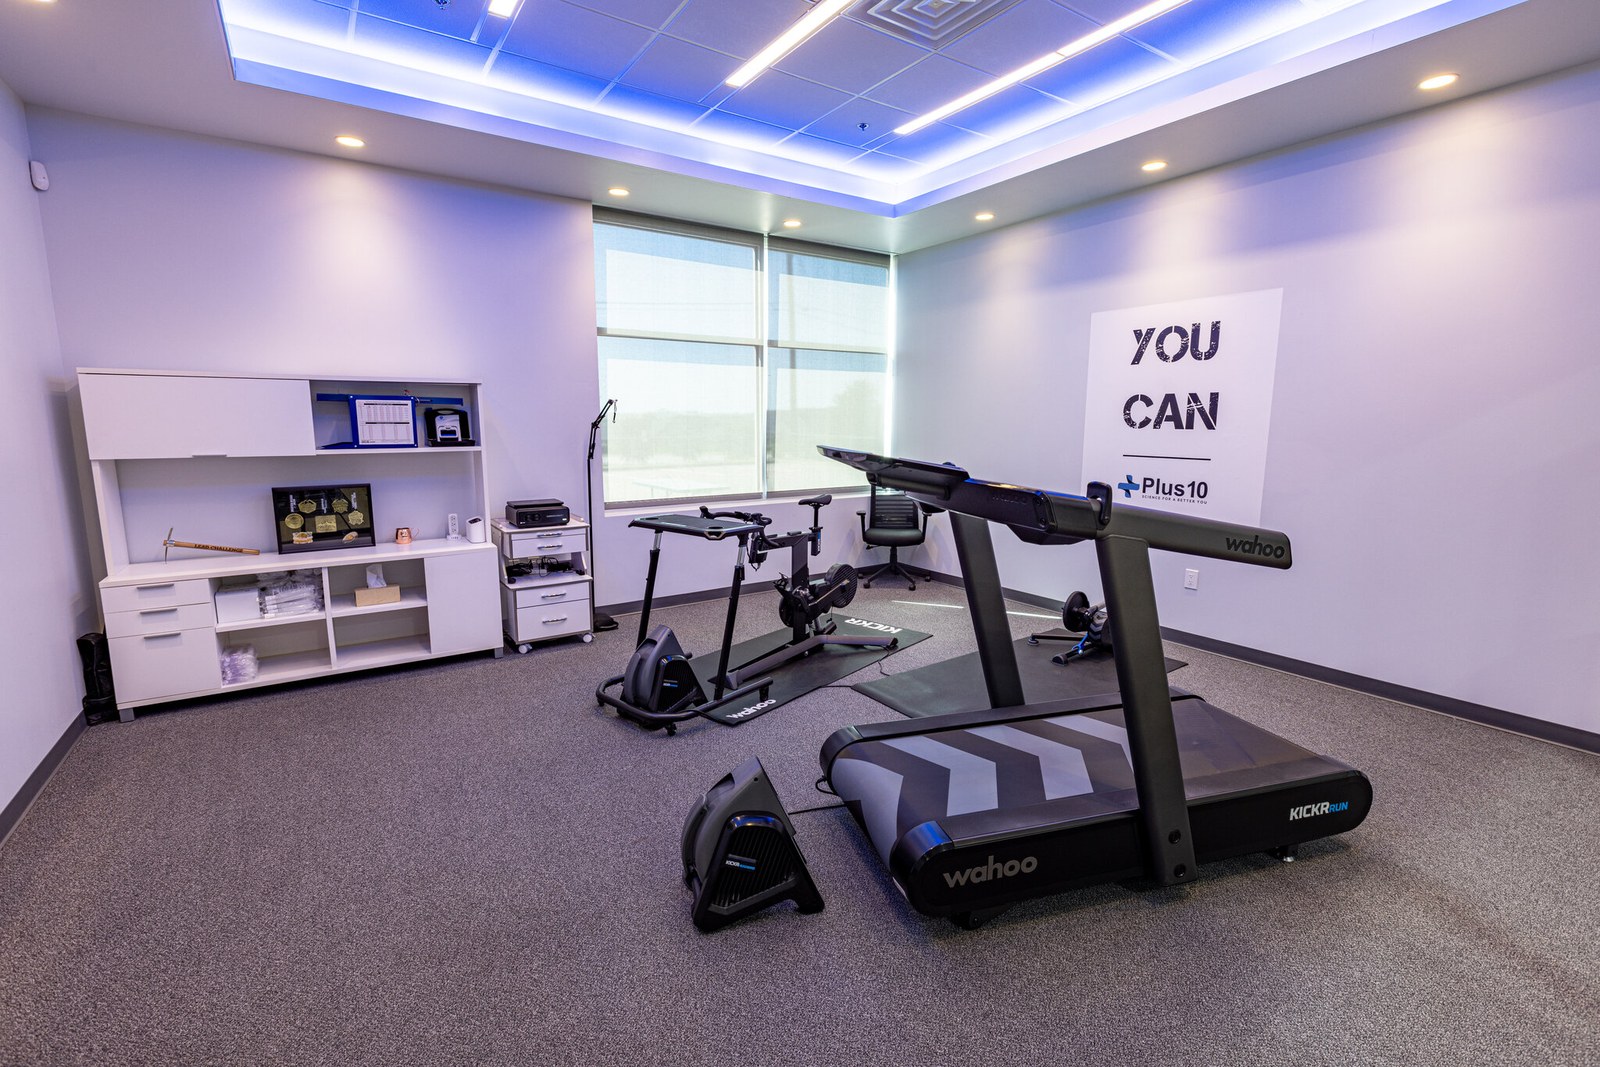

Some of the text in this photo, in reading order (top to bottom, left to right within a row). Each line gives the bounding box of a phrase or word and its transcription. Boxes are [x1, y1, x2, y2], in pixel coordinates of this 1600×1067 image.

[1130, 320, 1221, 365] YOU
[1123, 392, 1219, 430] CAN
[1142, 477, 1208, 499] Plus10
[1225, 534, 1285, 559] wahoo
[844, 618, 902, 634] KICKR
[725, 699, 776, 719] wahoo
[943, 855, 1038, 889] wahoo
